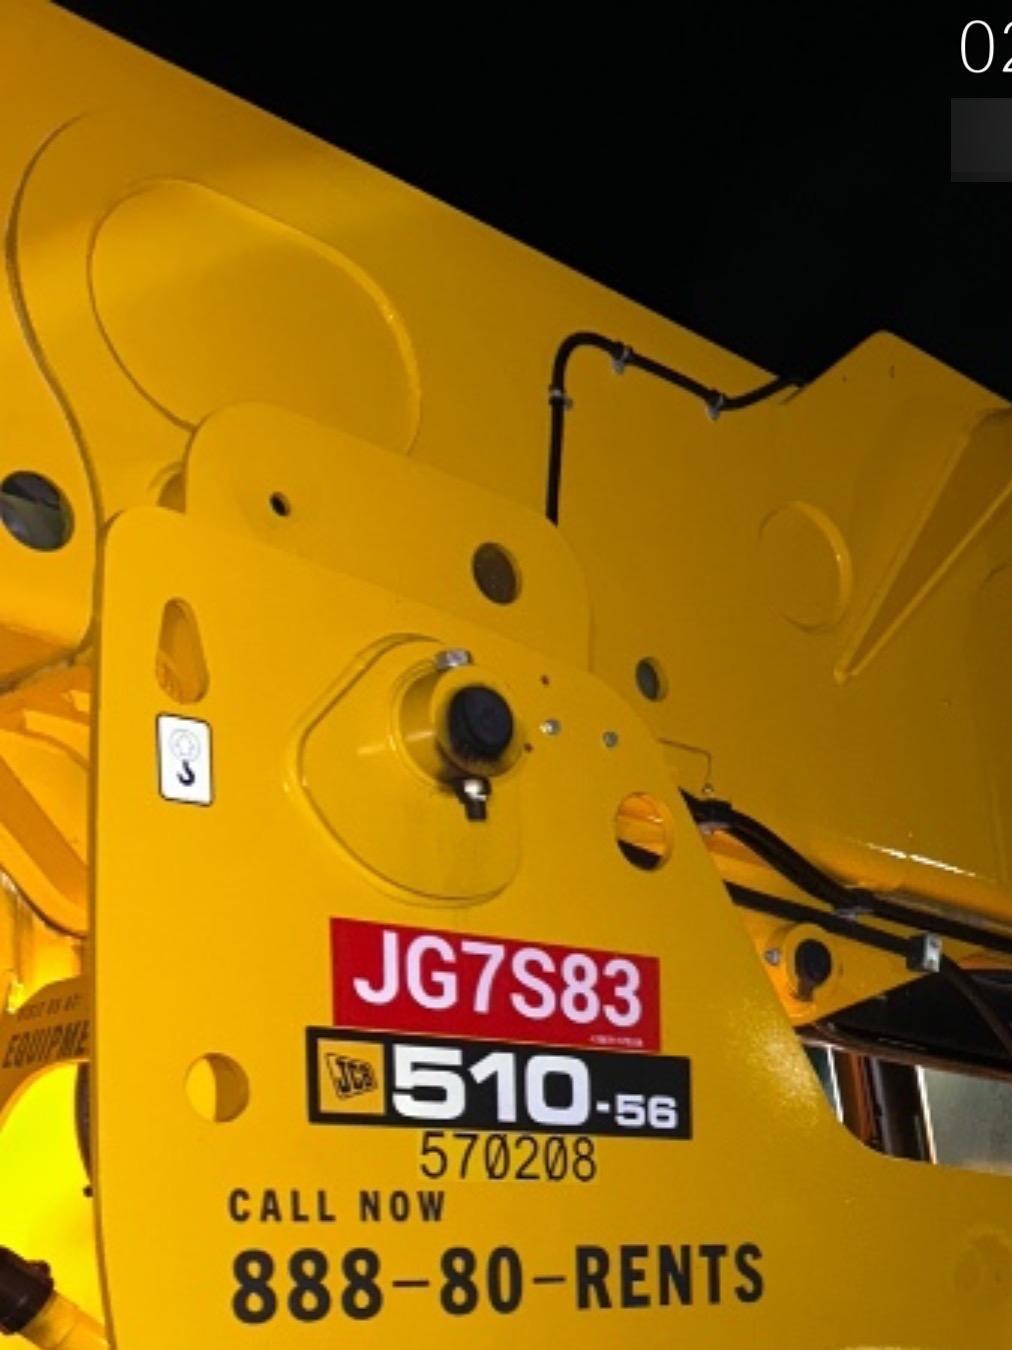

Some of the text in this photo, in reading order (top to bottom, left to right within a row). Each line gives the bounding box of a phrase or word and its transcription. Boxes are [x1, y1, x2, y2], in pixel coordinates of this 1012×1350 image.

[353, 929, 644, 1028] JG7S83
[420, 1131, 598, 1183] 570208
[229, 1189, 445, 1223] CALL NOW
[232, 1242, 765, 1324] 888-80-RENTS
